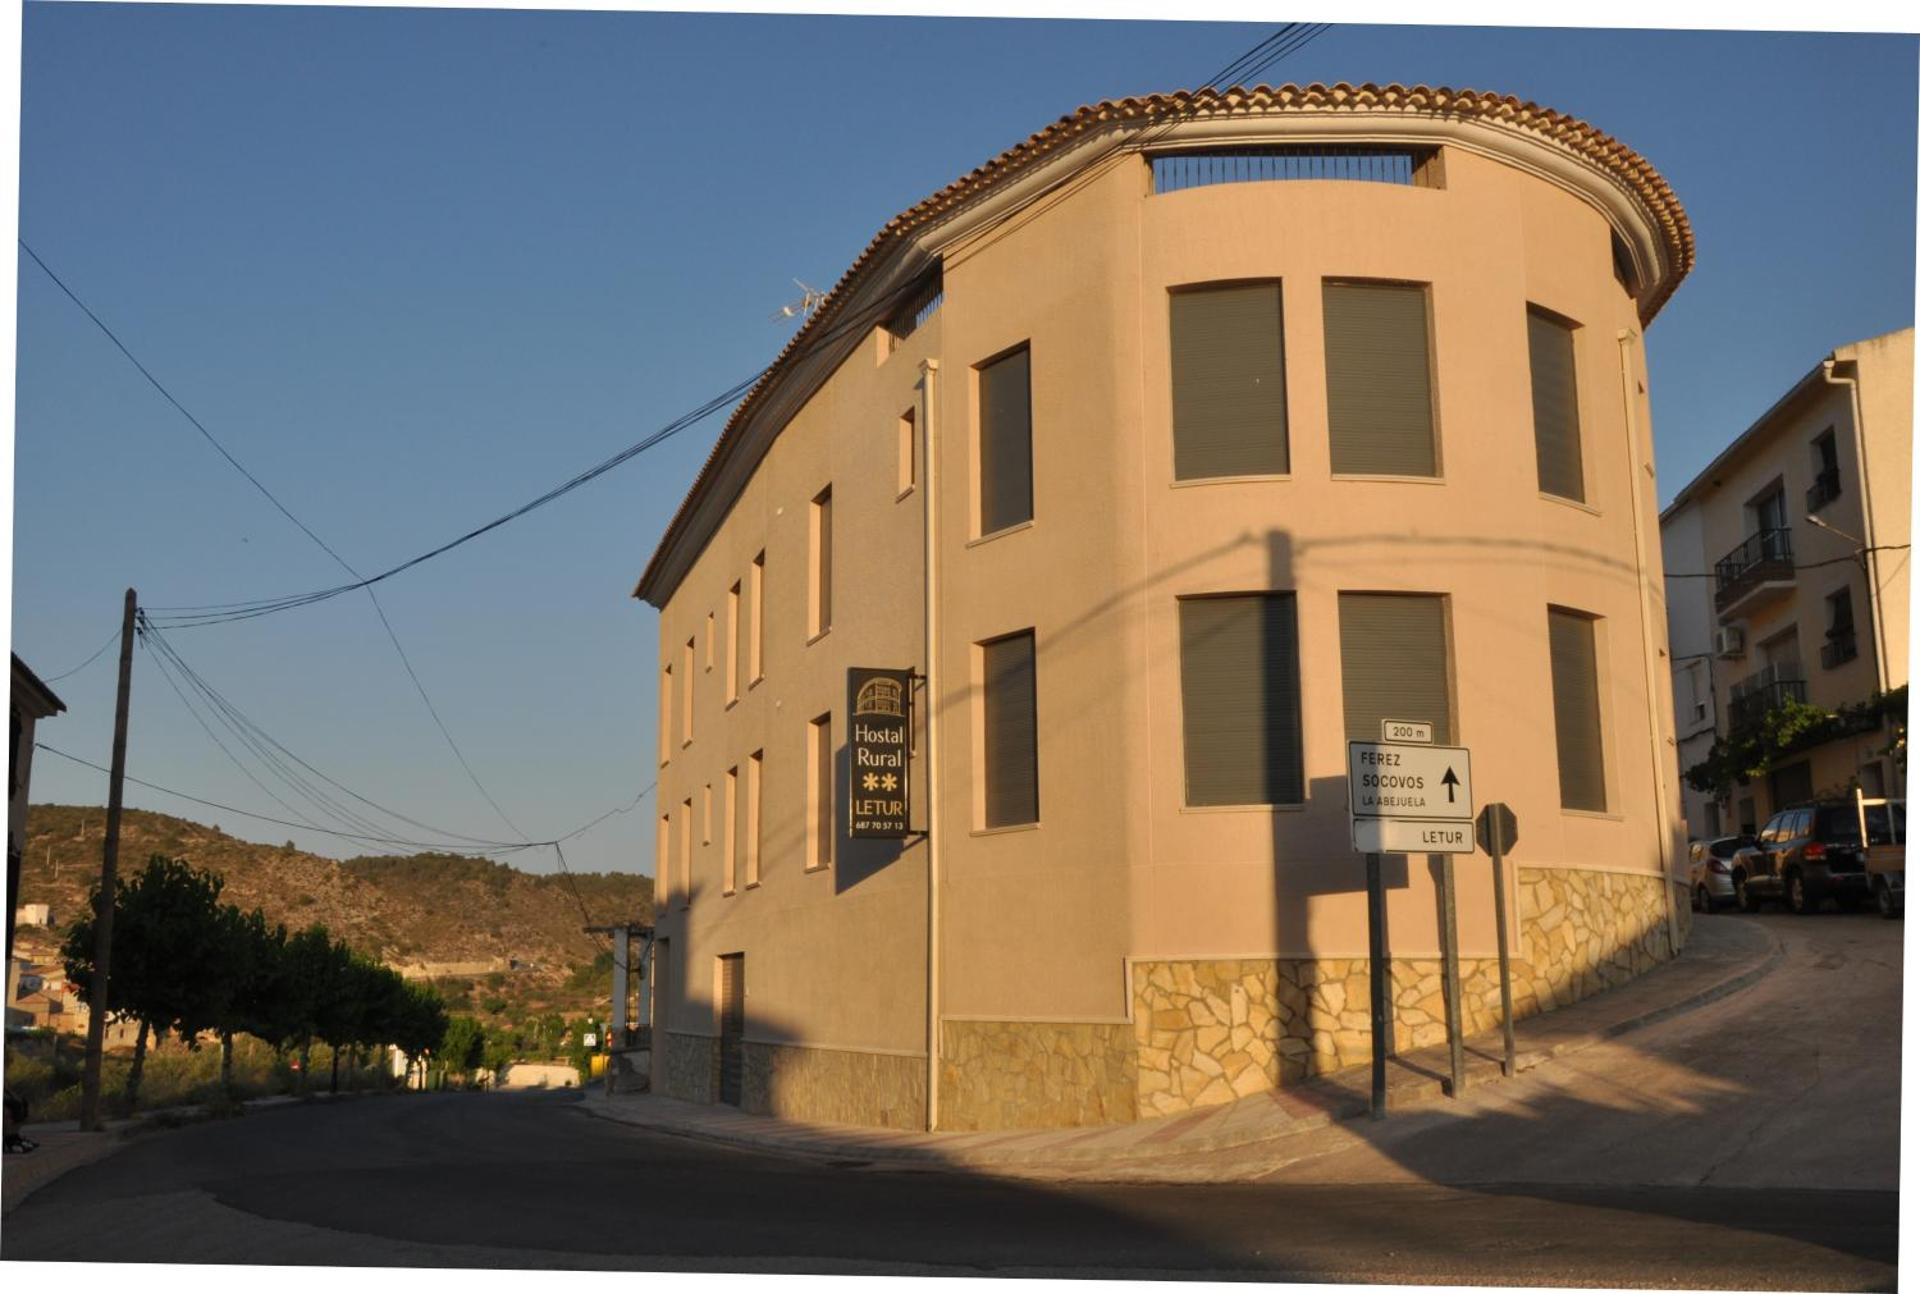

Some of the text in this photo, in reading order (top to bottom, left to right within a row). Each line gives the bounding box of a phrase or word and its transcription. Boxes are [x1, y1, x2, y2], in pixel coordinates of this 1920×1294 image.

[855, 723, 903, 744] Hostal
[1393, 726, 1424, 737] 200 m
[858, 747, 901, 767] Rural
[1361, 752, 1401, 766] FEREZ
[1362, 774, 1424, 789] SOCOVOS
[855, 799, 903, 816] LETUR
[1362, 796, 1426, 807] LA ABEJUELA
[1422, 831, 1463, 844] LETUR
